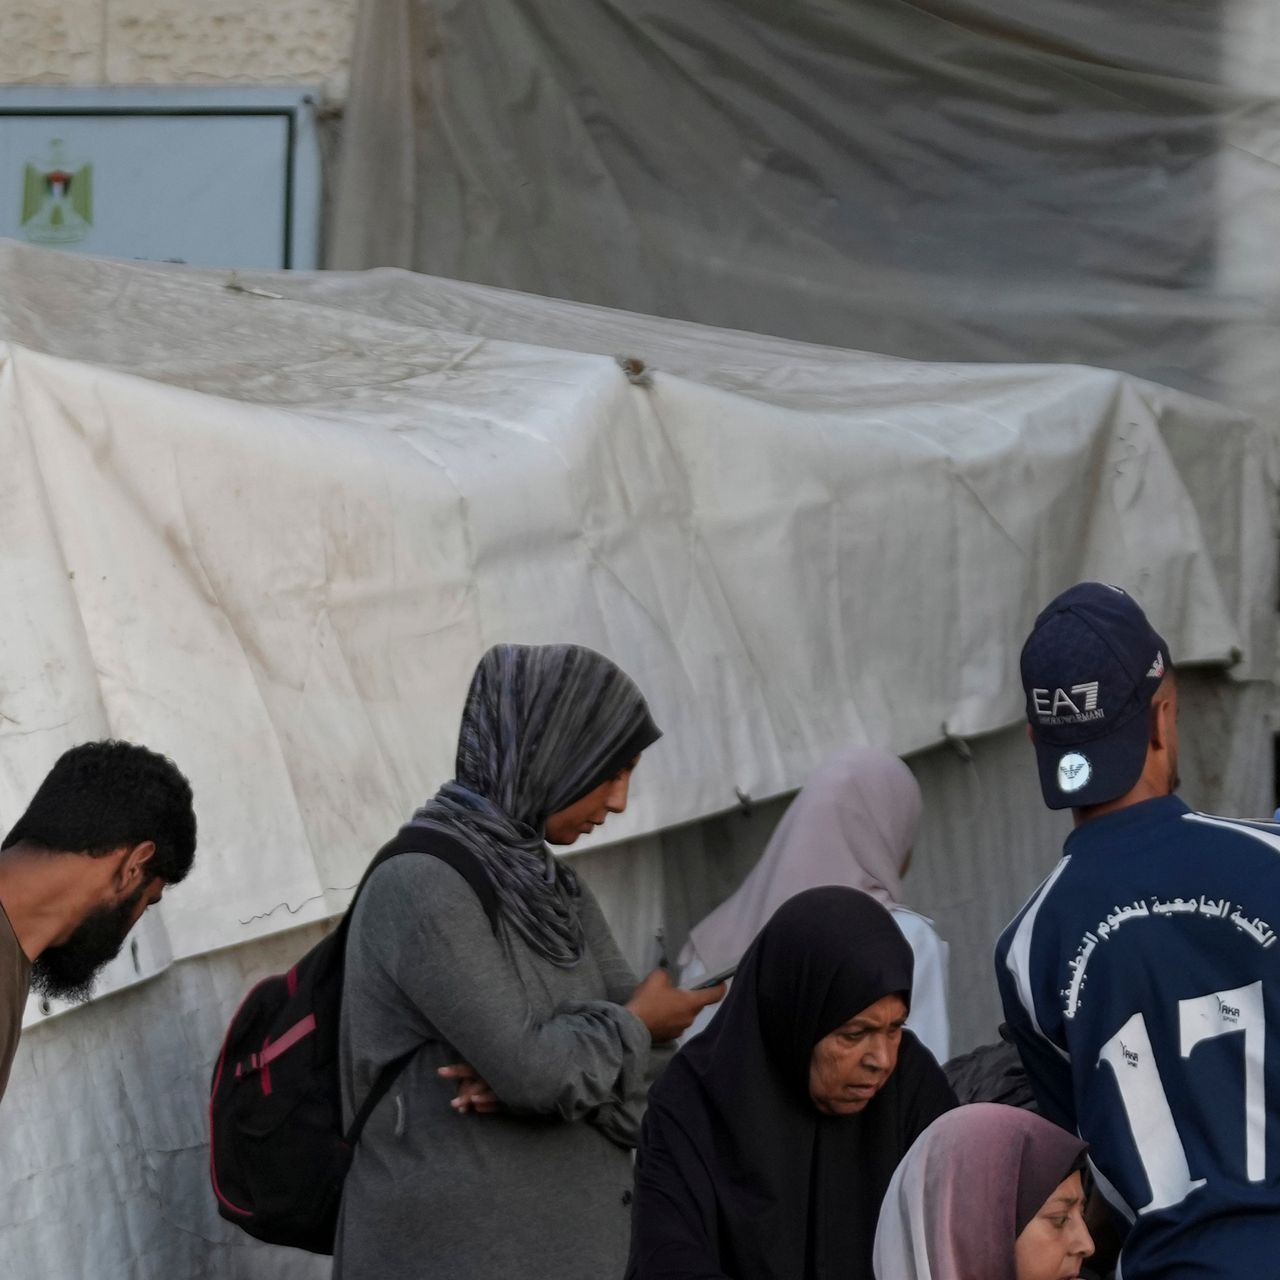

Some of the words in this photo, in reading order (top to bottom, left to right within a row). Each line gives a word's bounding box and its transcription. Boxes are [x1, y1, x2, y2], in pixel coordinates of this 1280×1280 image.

[1033, 681, 1099, 717] EA7
[1097, 899, 1150, 941] للعلوم
[1151, 894, 1231, 918] الجامعية
[1230, 904, 1278, 948] الكلية
[1096, 979, 1266, 1215] 17
